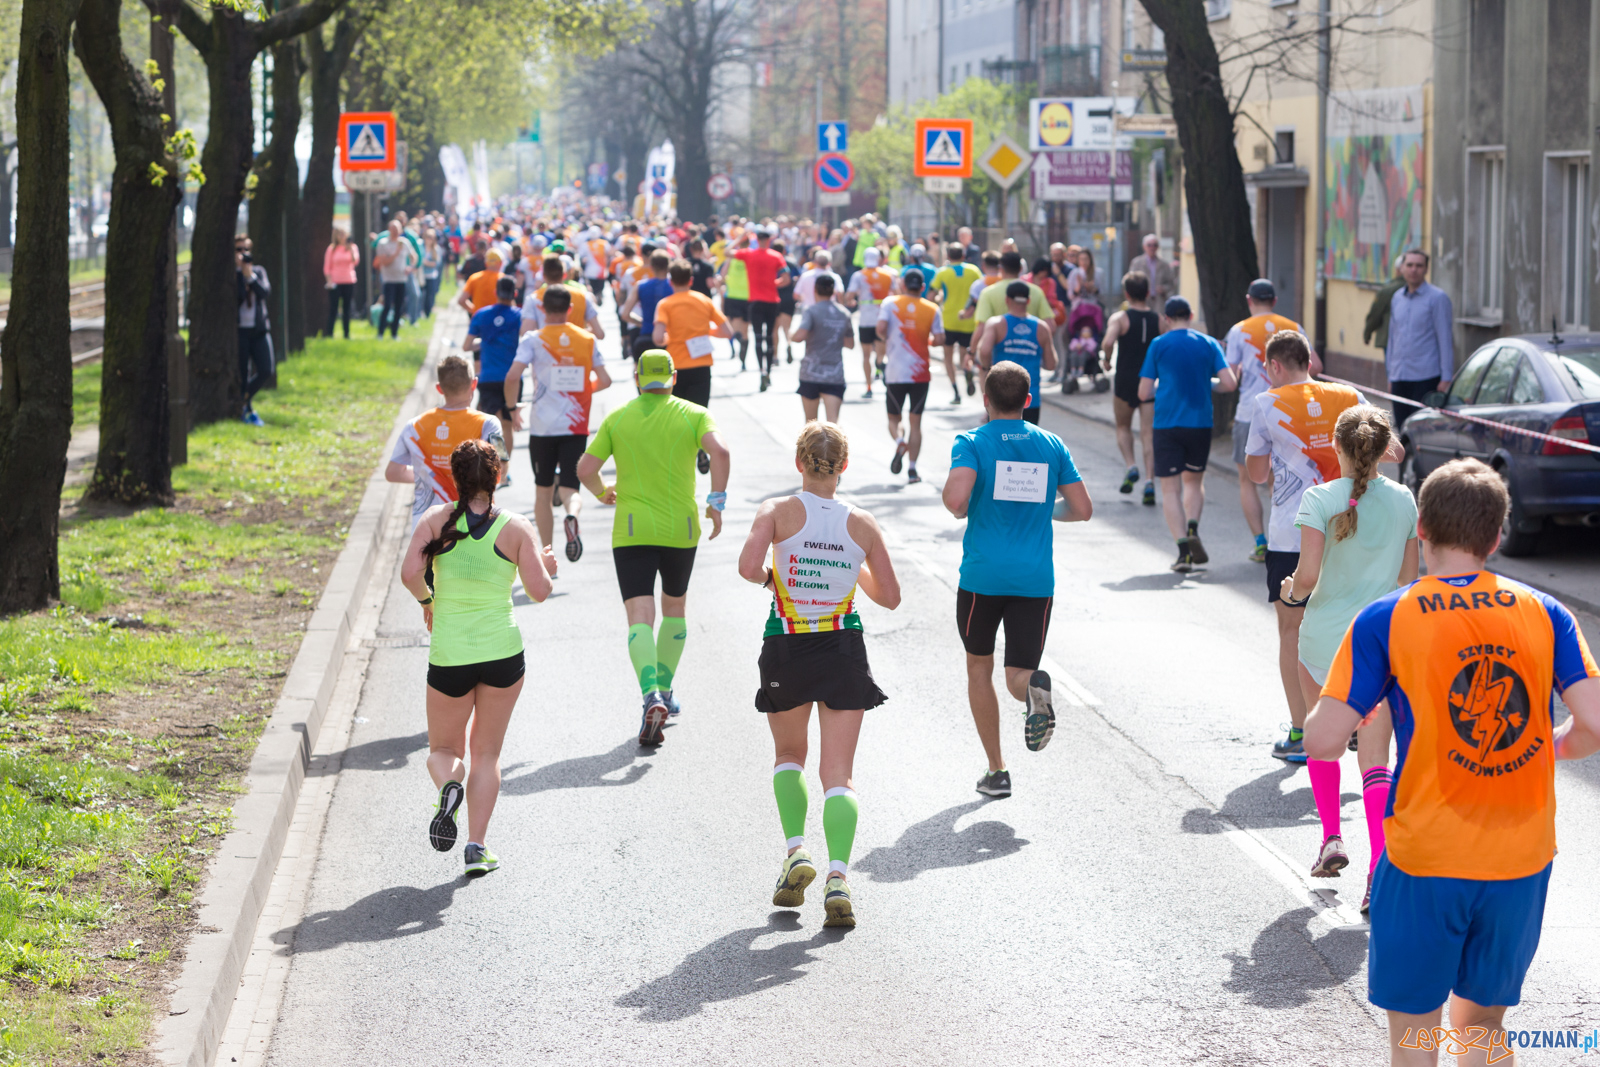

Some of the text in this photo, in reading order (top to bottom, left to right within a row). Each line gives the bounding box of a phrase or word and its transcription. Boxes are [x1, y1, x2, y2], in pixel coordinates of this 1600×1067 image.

[804, 541, 844, 552] EWELINA
[1416, 589, 1516, 614] MARO
[1457, 644, 1517, 662] SZYBCY
